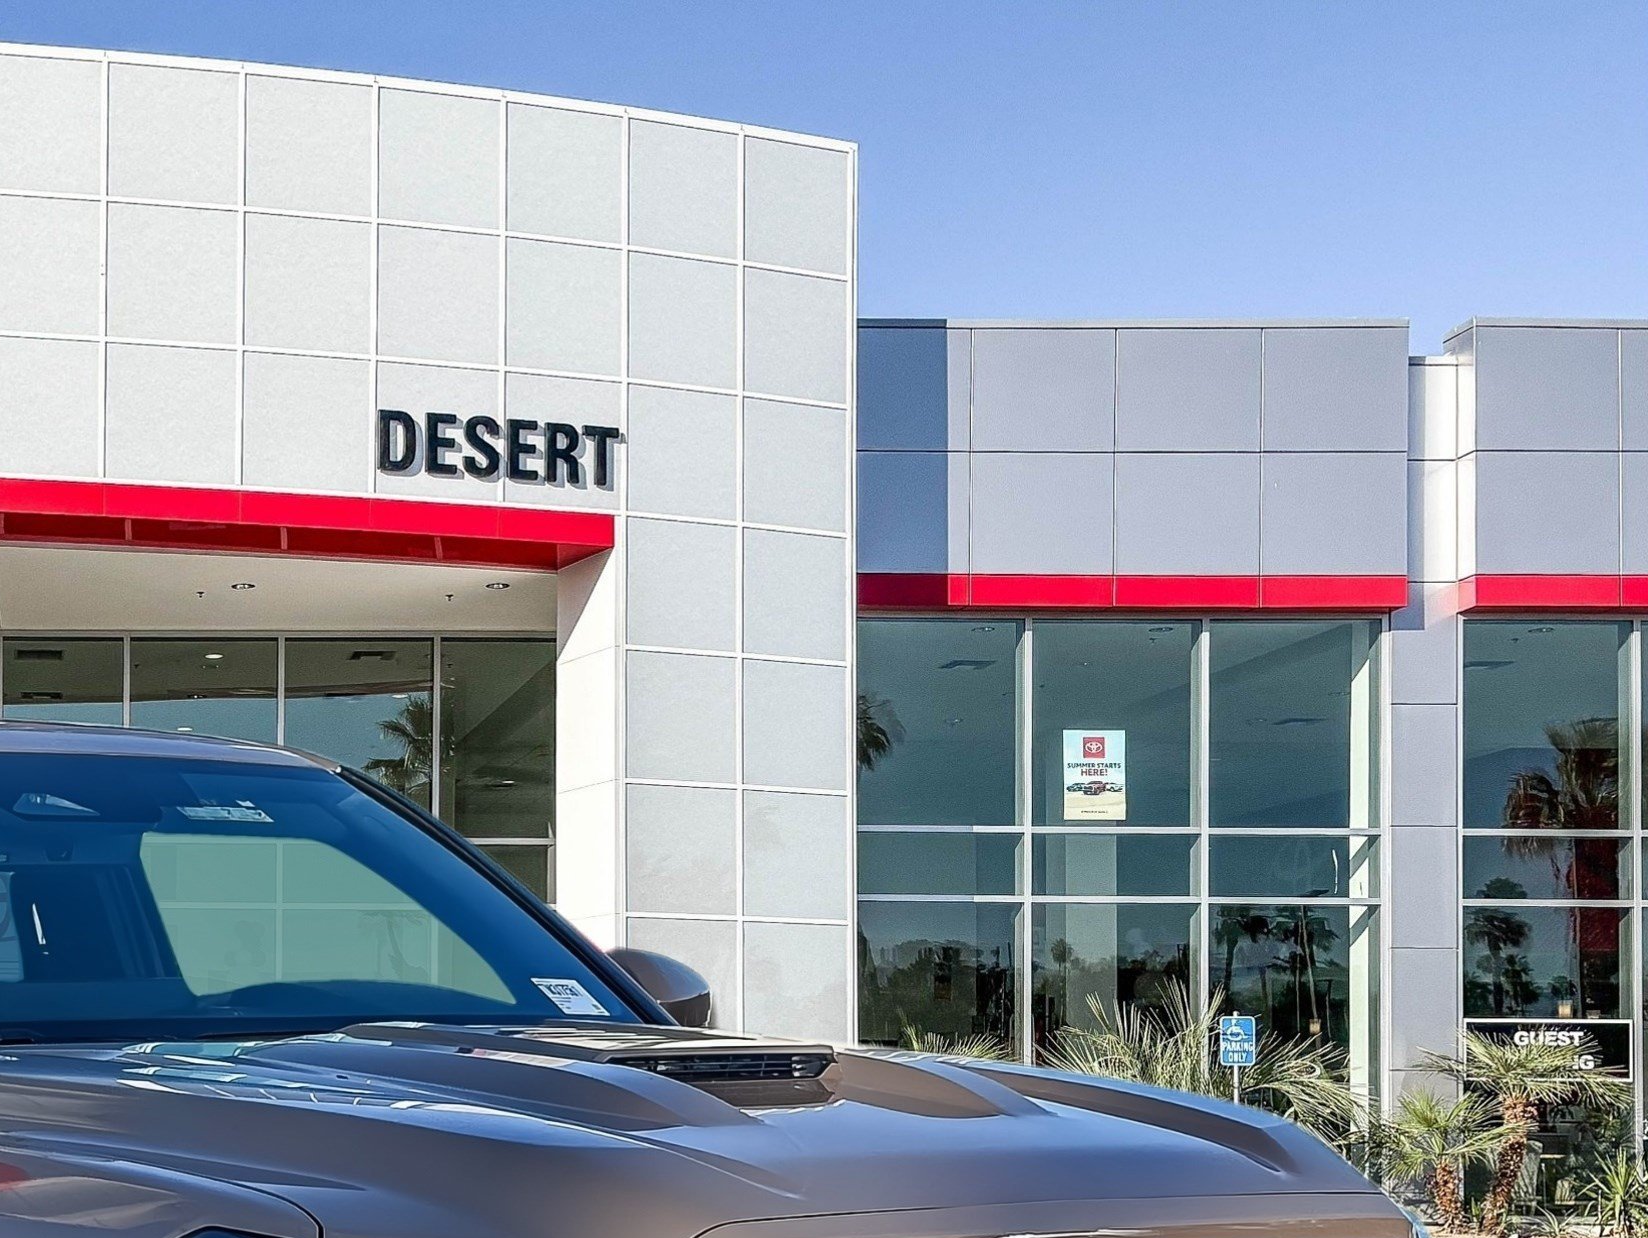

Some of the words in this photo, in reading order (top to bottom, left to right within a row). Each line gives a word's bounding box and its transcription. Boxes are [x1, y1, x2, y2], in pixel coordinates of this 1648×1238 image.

[377, 409, 619, 486] DESERT
[1080, 768, 1108, 776] HERE!
[1513, 1031, 1584, 1047] GUEST
[1222, 1041, 1254, 1052] PARKING
[1228, 1052, 1248, 1062] ONLY
